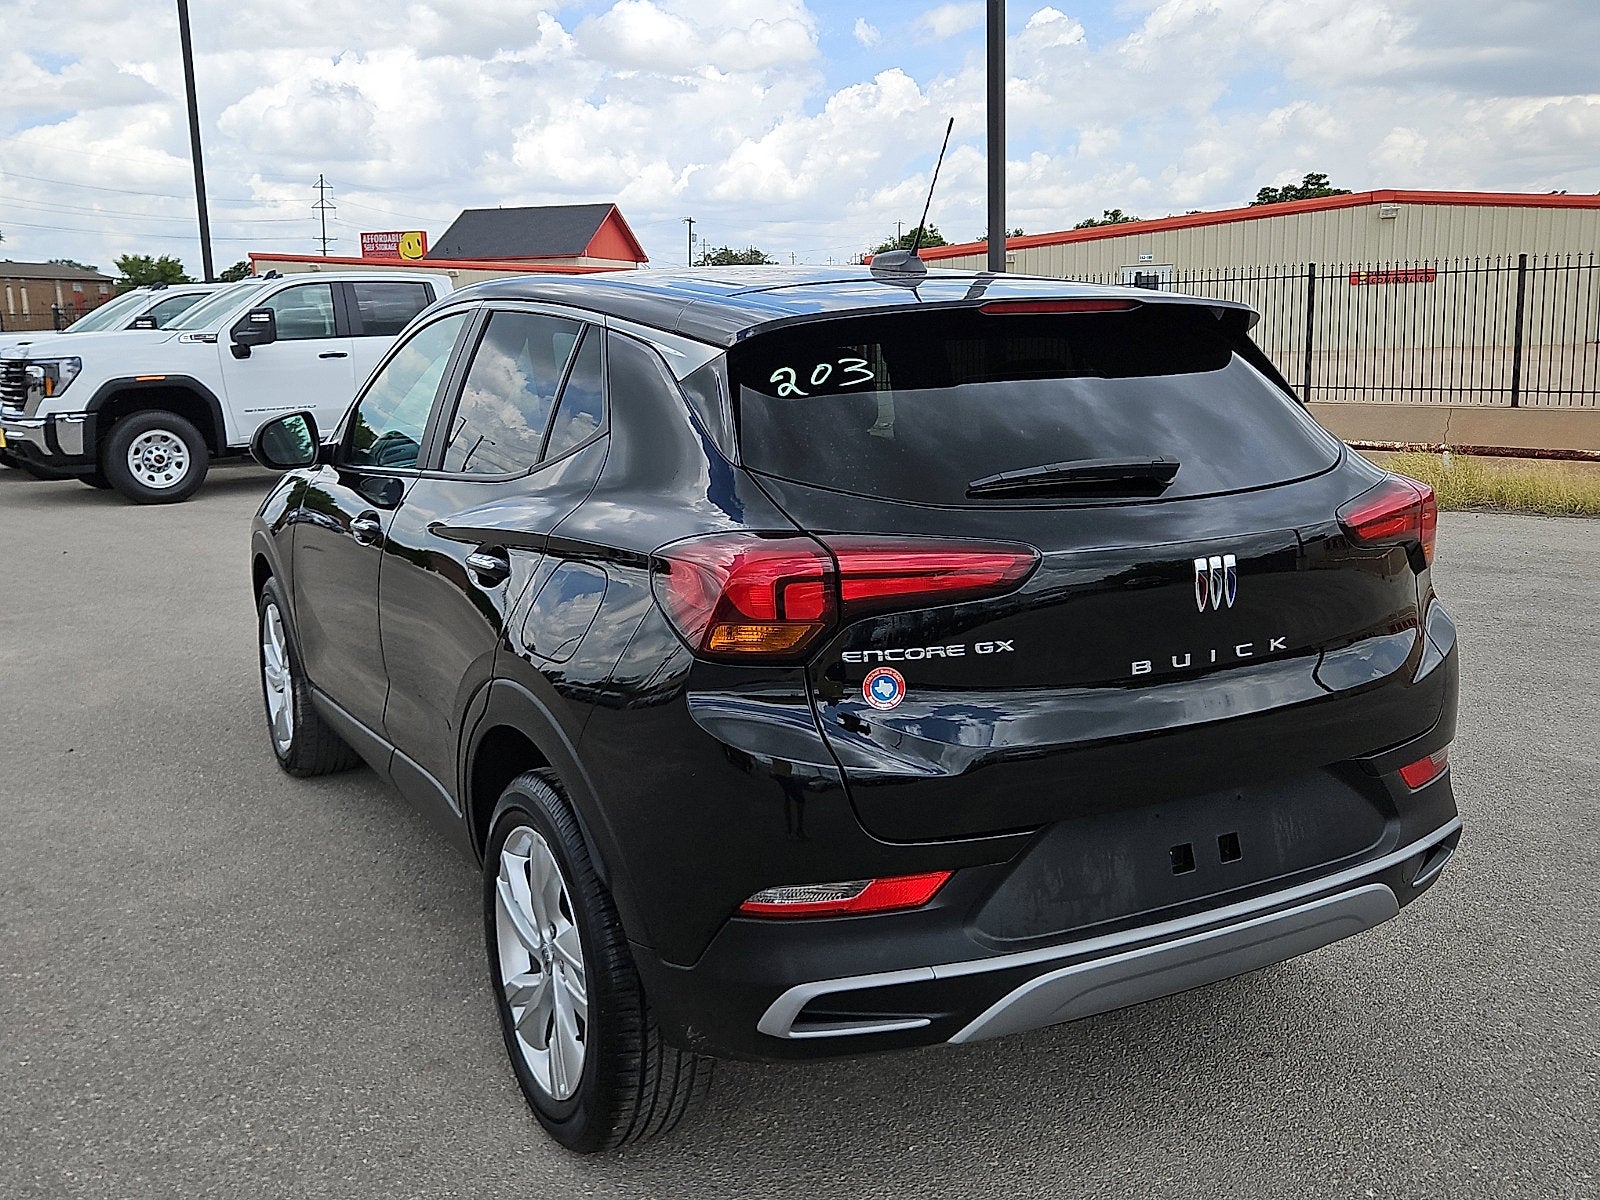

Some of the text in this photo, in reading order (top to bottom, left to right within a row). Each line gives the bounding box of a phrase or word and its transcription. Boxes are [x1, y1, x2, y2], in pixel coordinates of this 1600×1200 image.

[362, 233, 404, 243] AFFORDABLE
[364, 243, 398, 251] SELF STORAGE
[769, 358, 875, 397] 203
[841, 639, 1015, 663] ENCORE GX
[1131, 636, 1287, 675] BUICK
